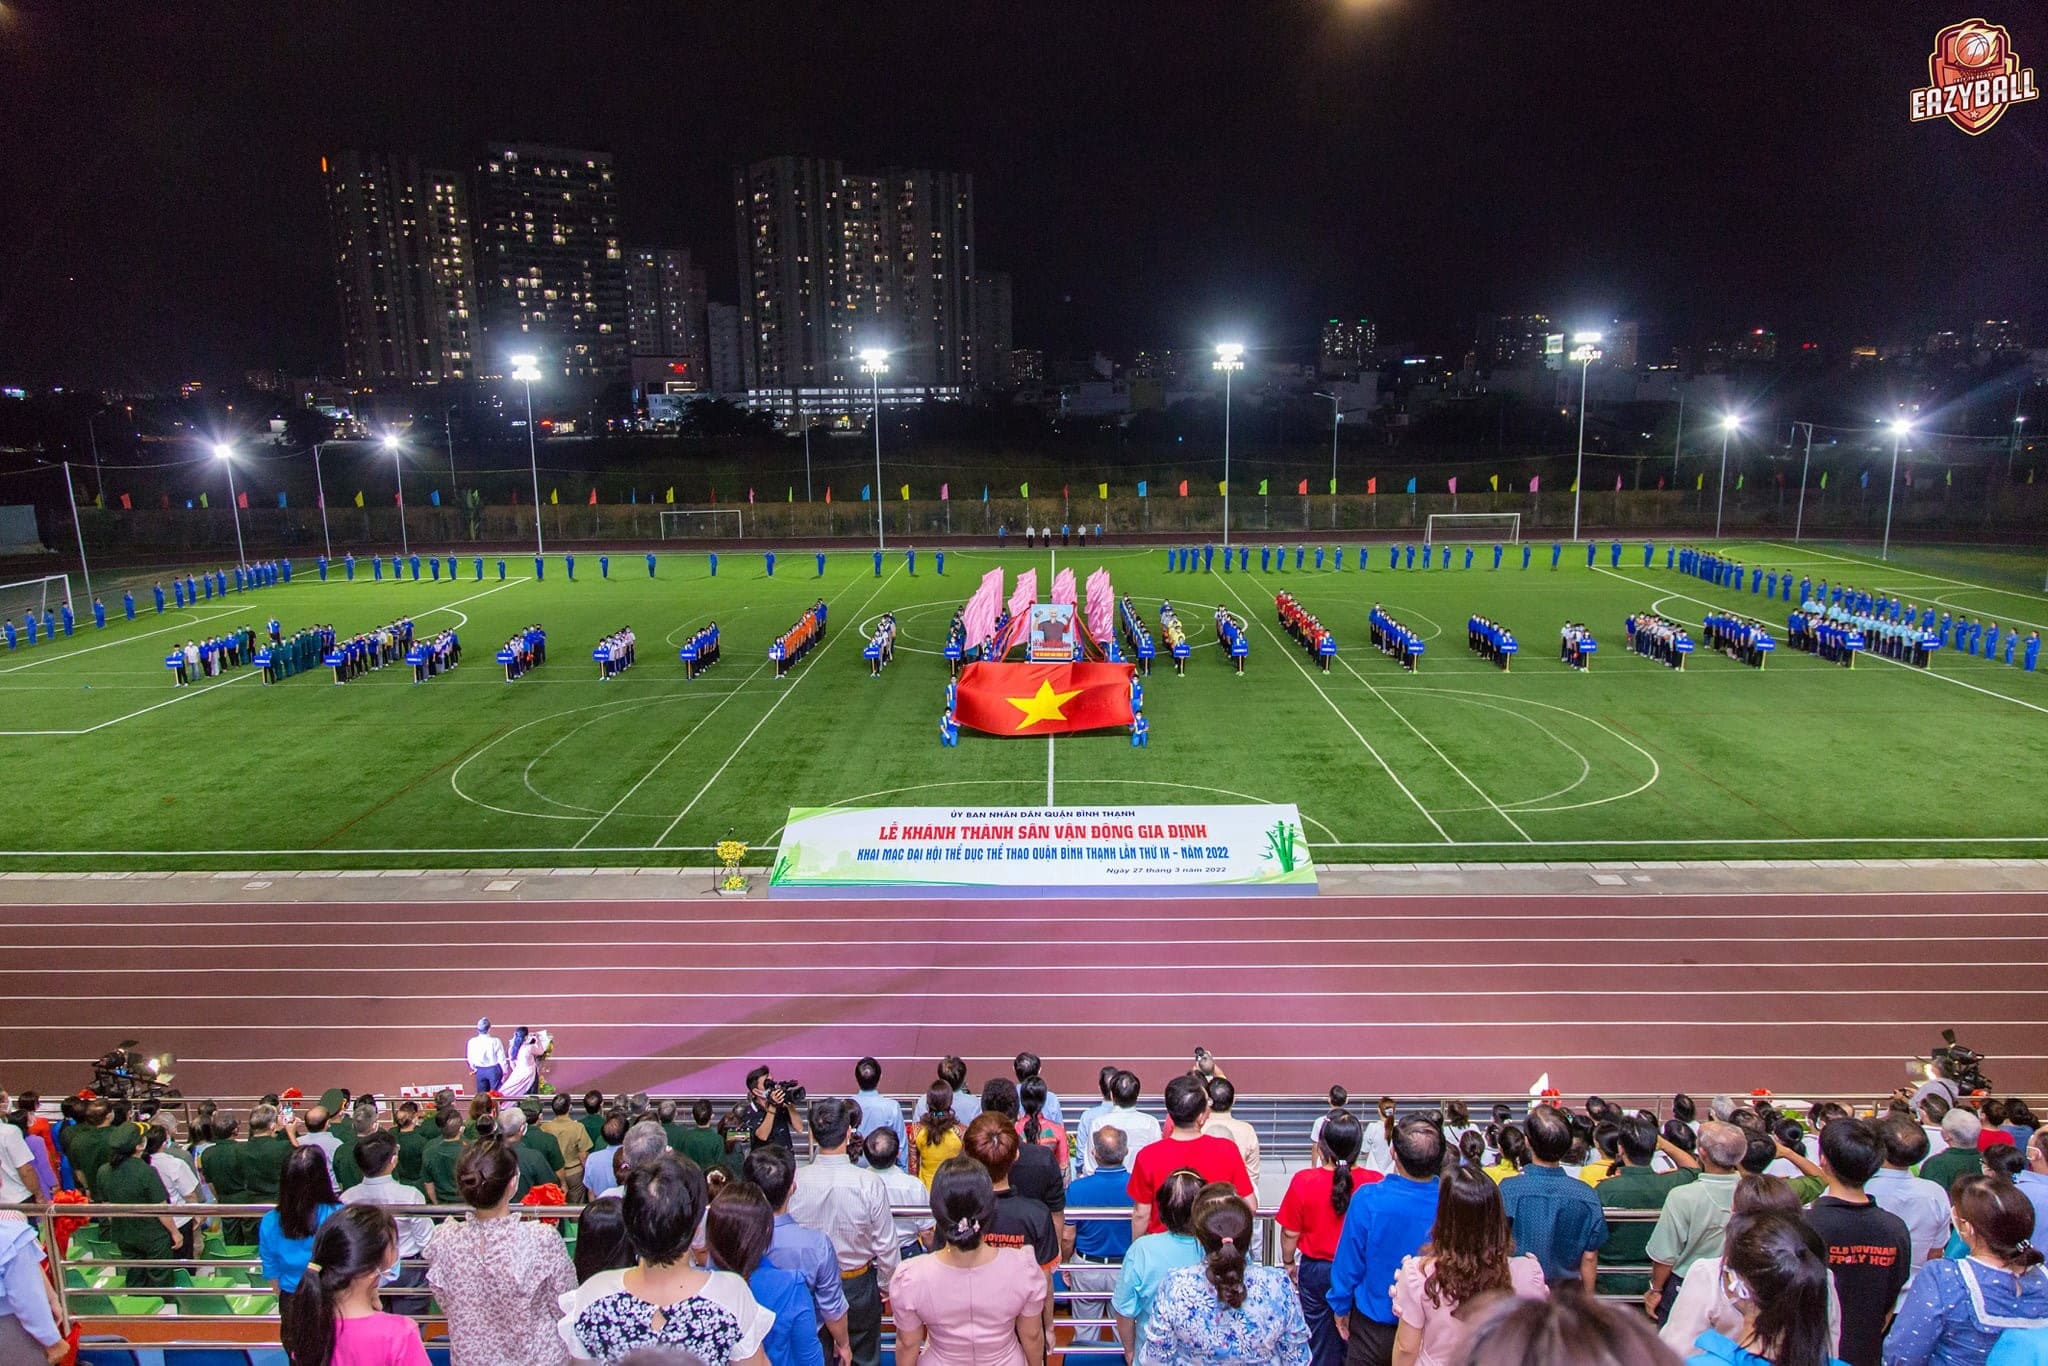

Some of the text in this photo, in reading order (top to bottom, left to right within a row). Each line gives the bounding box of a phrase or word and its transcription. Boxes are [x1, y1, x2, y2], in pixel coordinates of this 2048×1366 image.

[950, 809, 963, 818] ỦY
[1044, 810, 1073, 819] QUẬN
[1076, 809, 1099, 817] BÌNH
[1102, 810, 1135, 819] THẠNH
[879, 820, 1208, 842] LỄ KHÁNH THÀNH SÂN VẬN ĐỘNG GIA ĐỊNH
[857, 848, 880, 861] KHAI
[882, 848, 904, 863] MẠC
[907, 848, 923, 863] ĐẠI
[926, 845, 942, 863] HỘI
[945, 843, 963, 860] THỂ
[964, 847, 983, 862] DỤC
[986, 842, 1004, 860] THỂ
[1006, 847, 1029, 860] THAO
[1032, 844, 1057, 862] QUẬN
[1060, 844, 1083, 860] BÌNH
[1086, 847, 1116, 862] THẠNH
[1119, 843, 1136, 859] LẦN
[1139, 844, 1157, 859] THỨ
[1160, 847, 1170, 859] IX
[1181, 845, 1204, 859] NĂM
[1206, 846, 1229, 859] 2022
[1829, 1245, 1849, 1255] CLB
